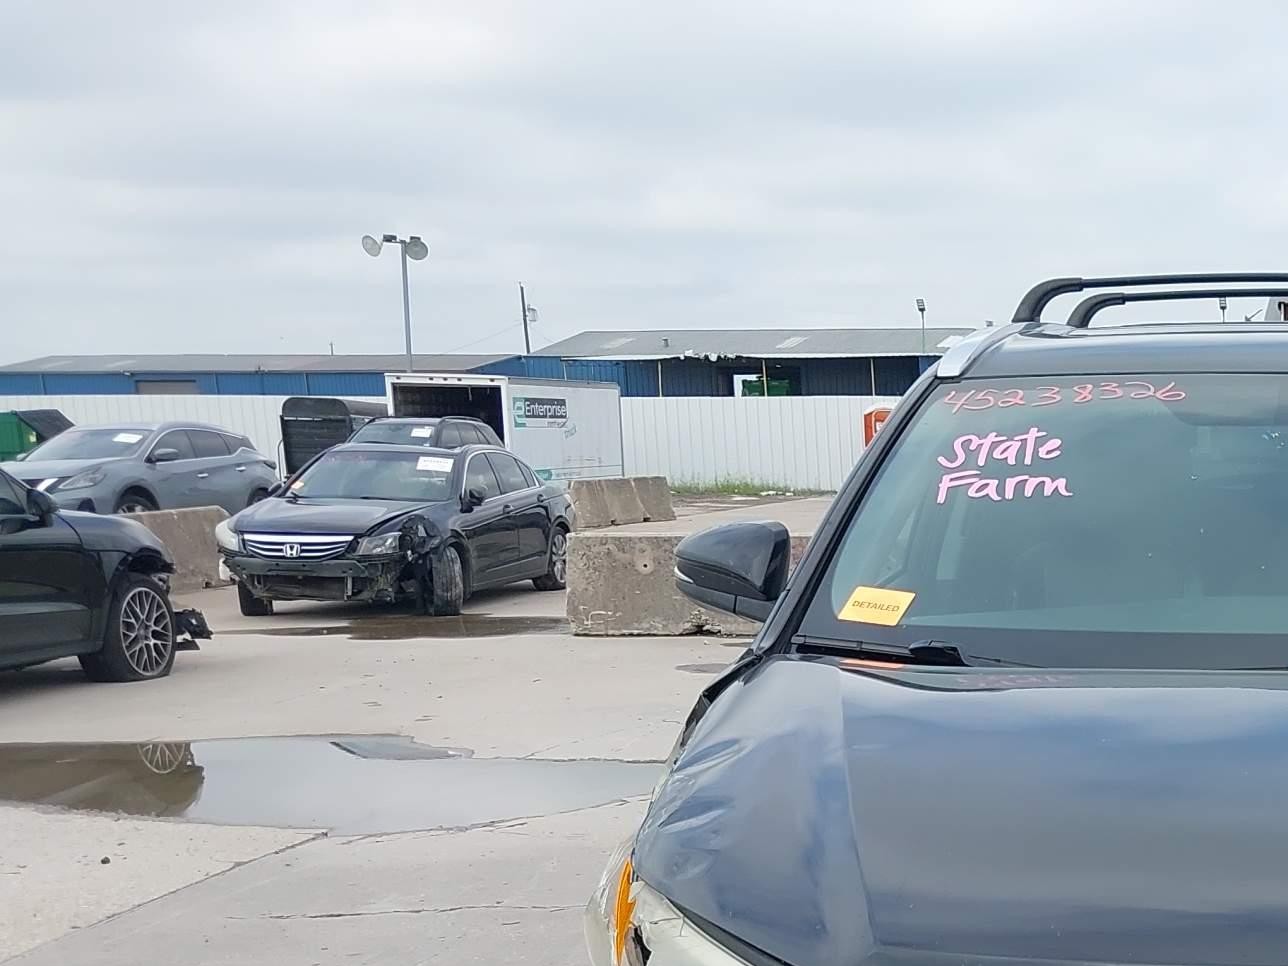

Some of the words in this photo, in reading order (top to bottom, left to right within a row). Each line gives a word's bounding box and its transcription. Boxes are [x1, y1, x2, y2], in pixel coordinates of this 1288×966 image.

[525, 400, 567, 419] Enterprise
[943, 381, 1187, 414] 45238326
[937, 427, 1063, 469] State
[936, 470, 1074, 504] Farm
[851, 600, 900, 612] DETAILED
